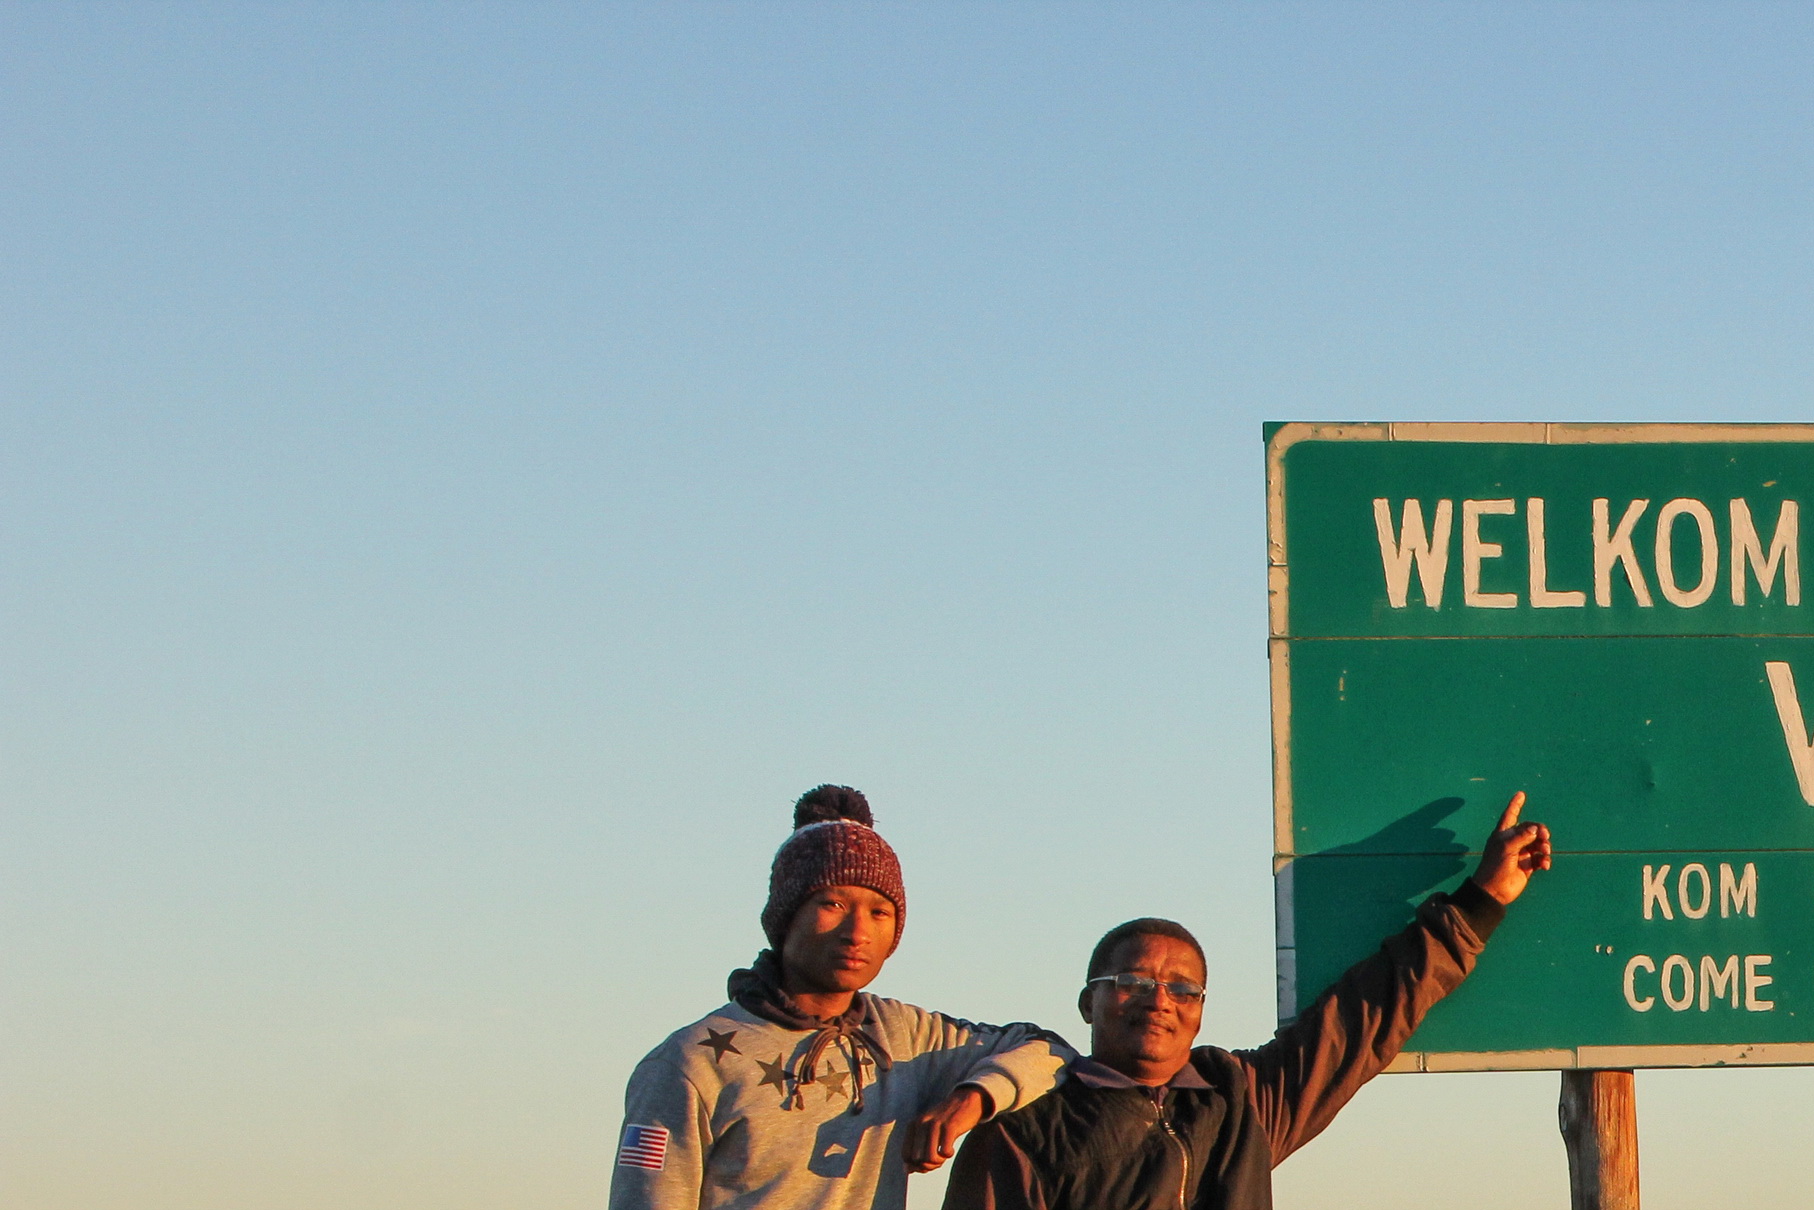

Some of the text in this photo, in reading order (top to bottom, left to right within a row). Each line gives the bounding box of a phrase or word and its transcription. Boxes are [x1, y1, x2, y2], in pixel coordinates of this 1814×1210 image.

[1373, 498, 1800, 609] WELKOM
[1642, 862, 1759, 921] KOM
[1622, 954, 1776, 1012] COME
